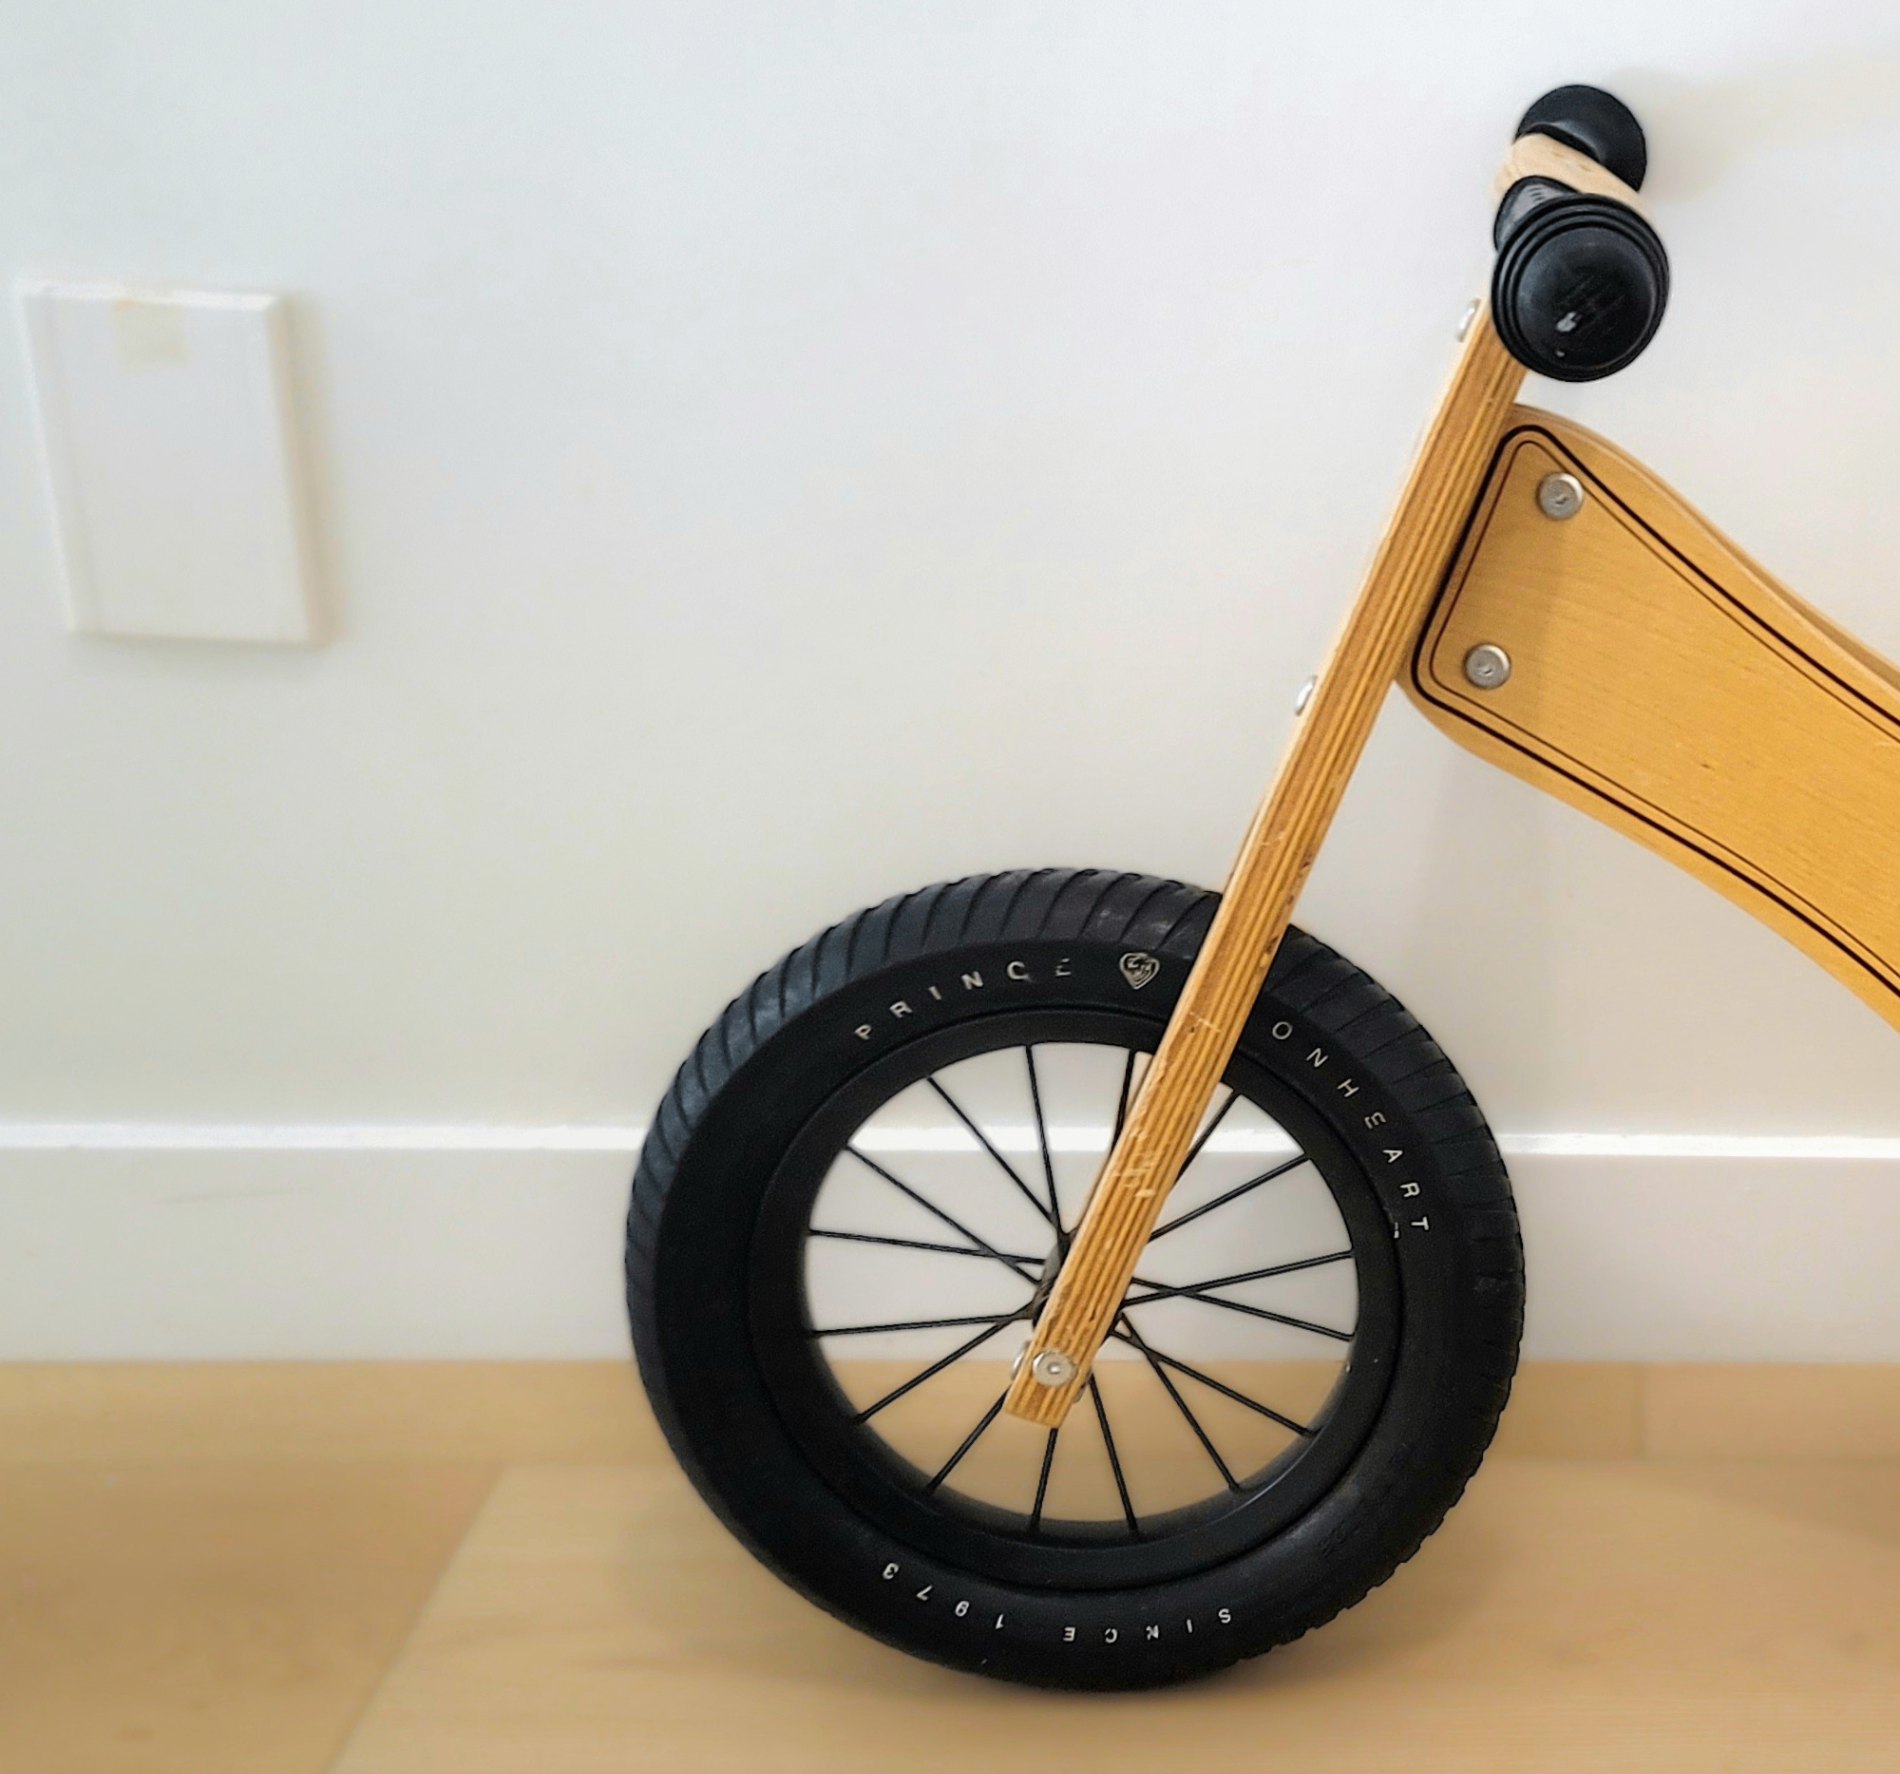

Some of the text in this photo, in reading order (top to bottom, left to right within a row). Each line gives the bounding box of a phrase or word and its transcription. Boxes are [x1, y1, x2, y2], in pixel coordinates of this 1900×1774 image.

[854, 957, 1430, 1231] PRINCE ONHEART
[882, 1562, 1232, 1644] SINCE 1973
